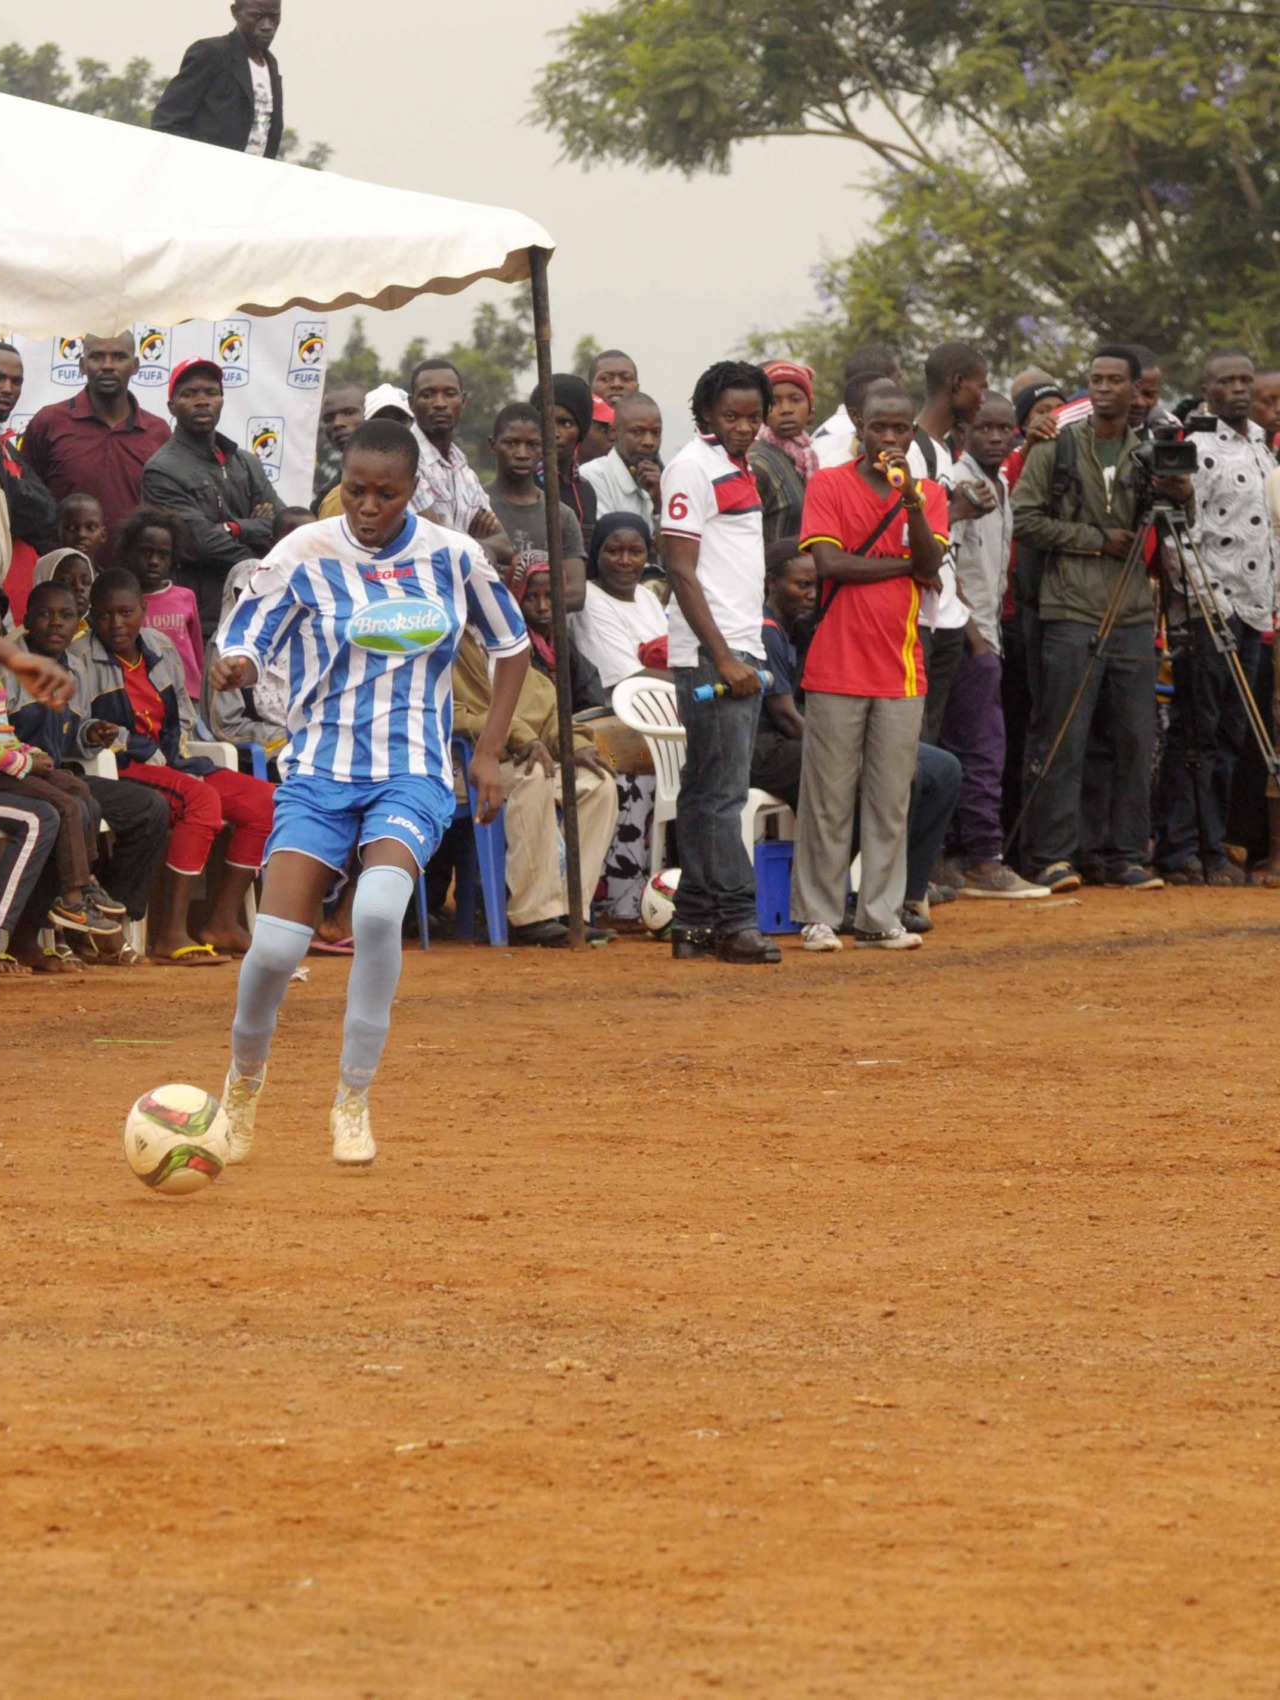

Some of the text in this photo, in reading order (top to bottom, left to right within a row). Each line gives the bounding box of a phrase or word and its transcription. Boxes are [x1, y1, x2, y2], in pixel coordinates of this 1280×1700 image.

[58, 369, 84, 380] FUFA
[138, 371, 163, 381] FUFA
[222, 372, 243, 382] UFA
[293, 373, 320, 384] FUFA
[668, 491, 689, 521] 6
[354, 608, 441, 635] Brookside
